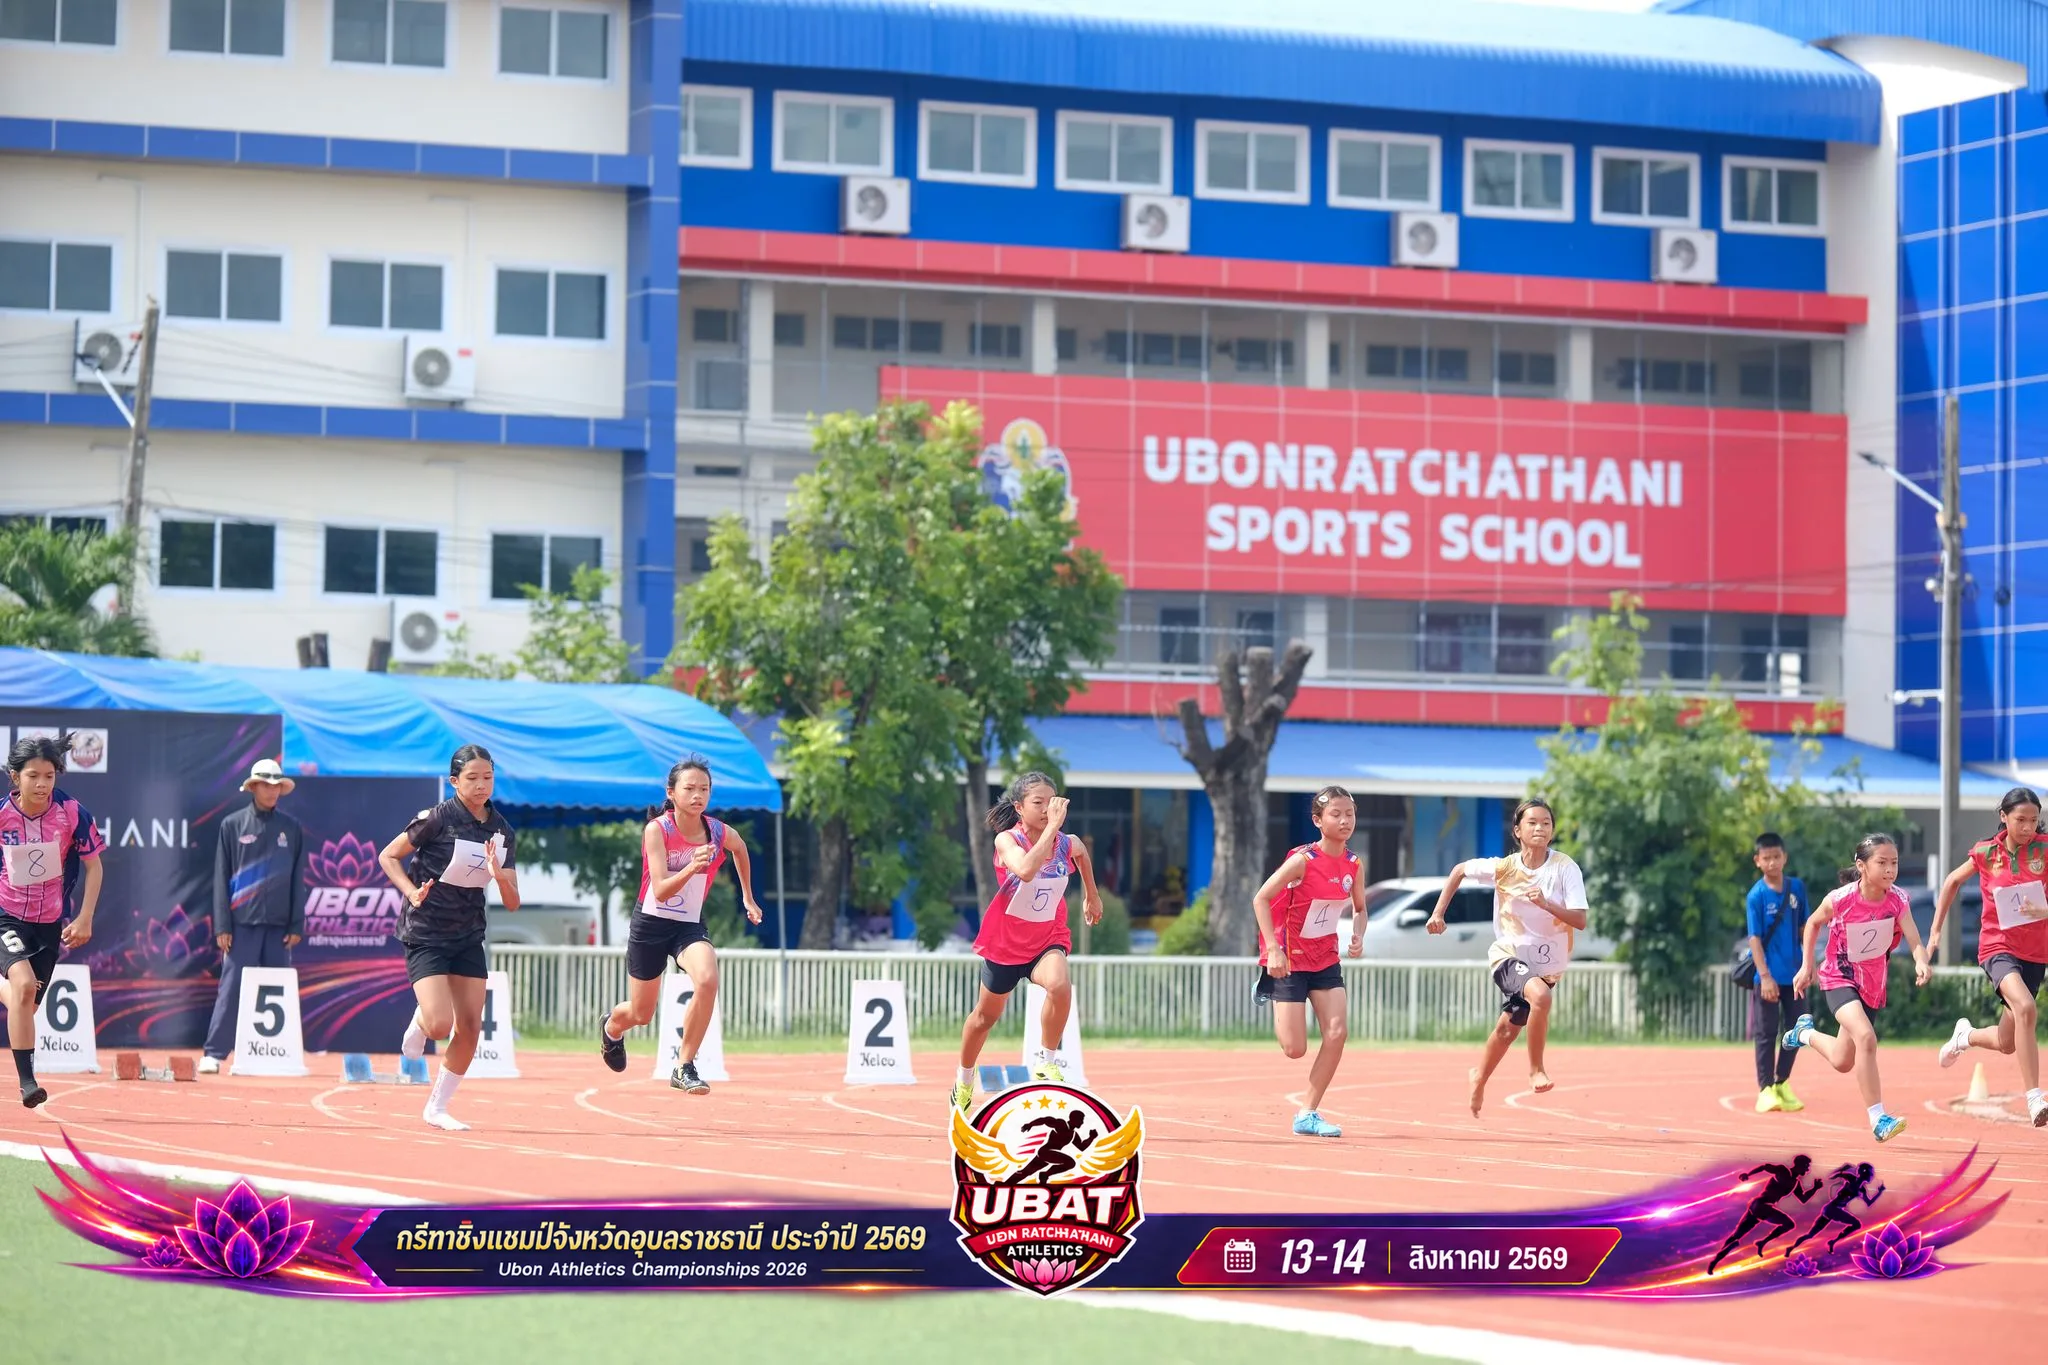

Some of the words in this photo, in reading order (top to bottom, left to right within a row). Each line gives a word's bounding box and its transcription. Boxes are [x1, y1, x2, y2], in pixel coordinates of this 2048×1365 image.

[1144, 435, 1683, 508] UBONRATCHATHANI
[1206, 503, 1411, 559] SPORTS
[1440, 513, 1642, 569] SCHOOL
[28, 849, 46, 877] 8
[466, 853, 486, 877] 7
[1031, 888, 1052, 912] 5
[1314, 903, 1330, 928] 4
[1, 930, 25, 953] 5
[1860, 928, 1878, 954] 2
[1535, 943, 1551, 965] 3
[46, 980, 78, 1032] 6
[253, 985, 285, 1037] 5
[864, 998, 894, 1047] 2
[40, 1036, 80, 1053] Nelco
[247, 1041, 286, 1057] Nelco
